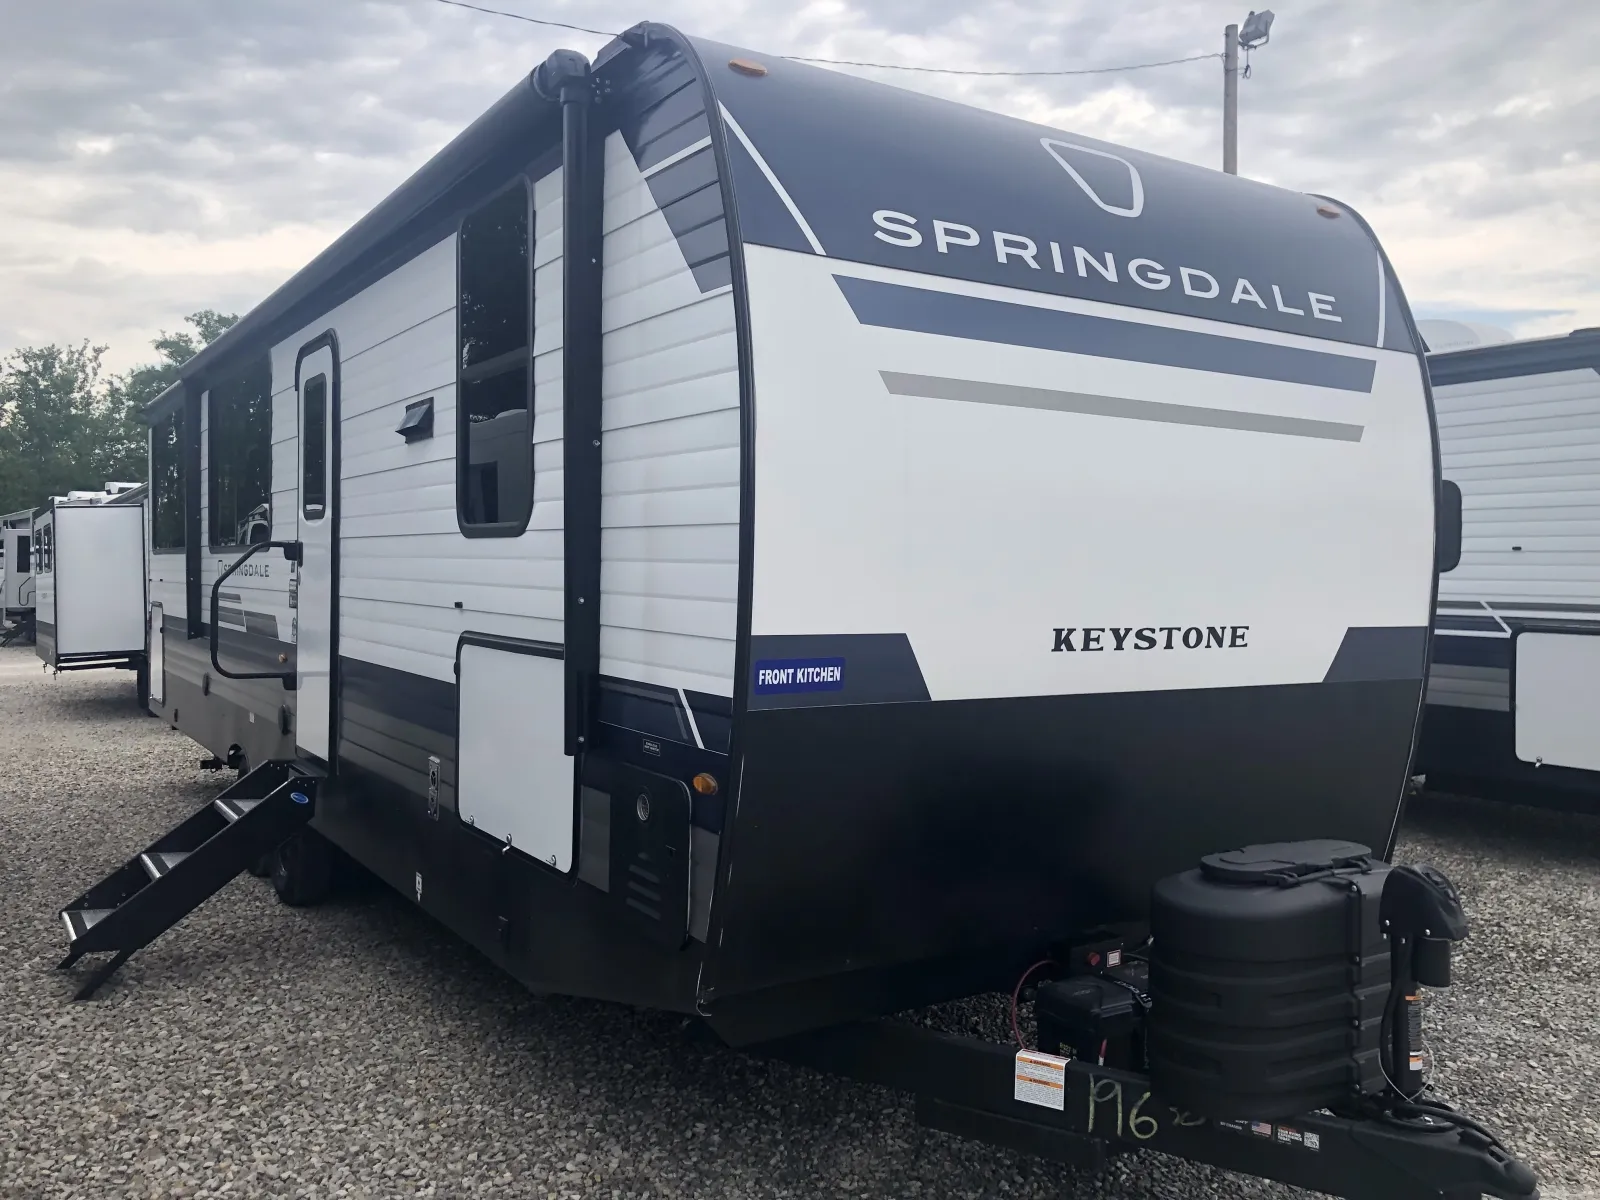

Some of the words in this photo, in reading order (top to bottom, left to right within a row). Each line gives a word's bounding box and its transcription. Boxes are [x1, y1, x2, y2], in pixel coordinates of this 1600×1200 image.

[872, 209, 1343, 324] SPRINGDALE
[1051, 625, 1250, 653] KEYSTONE
[758, 668, 794, 686] FRONT
[795, 666, 841, 684] KITCHEN
